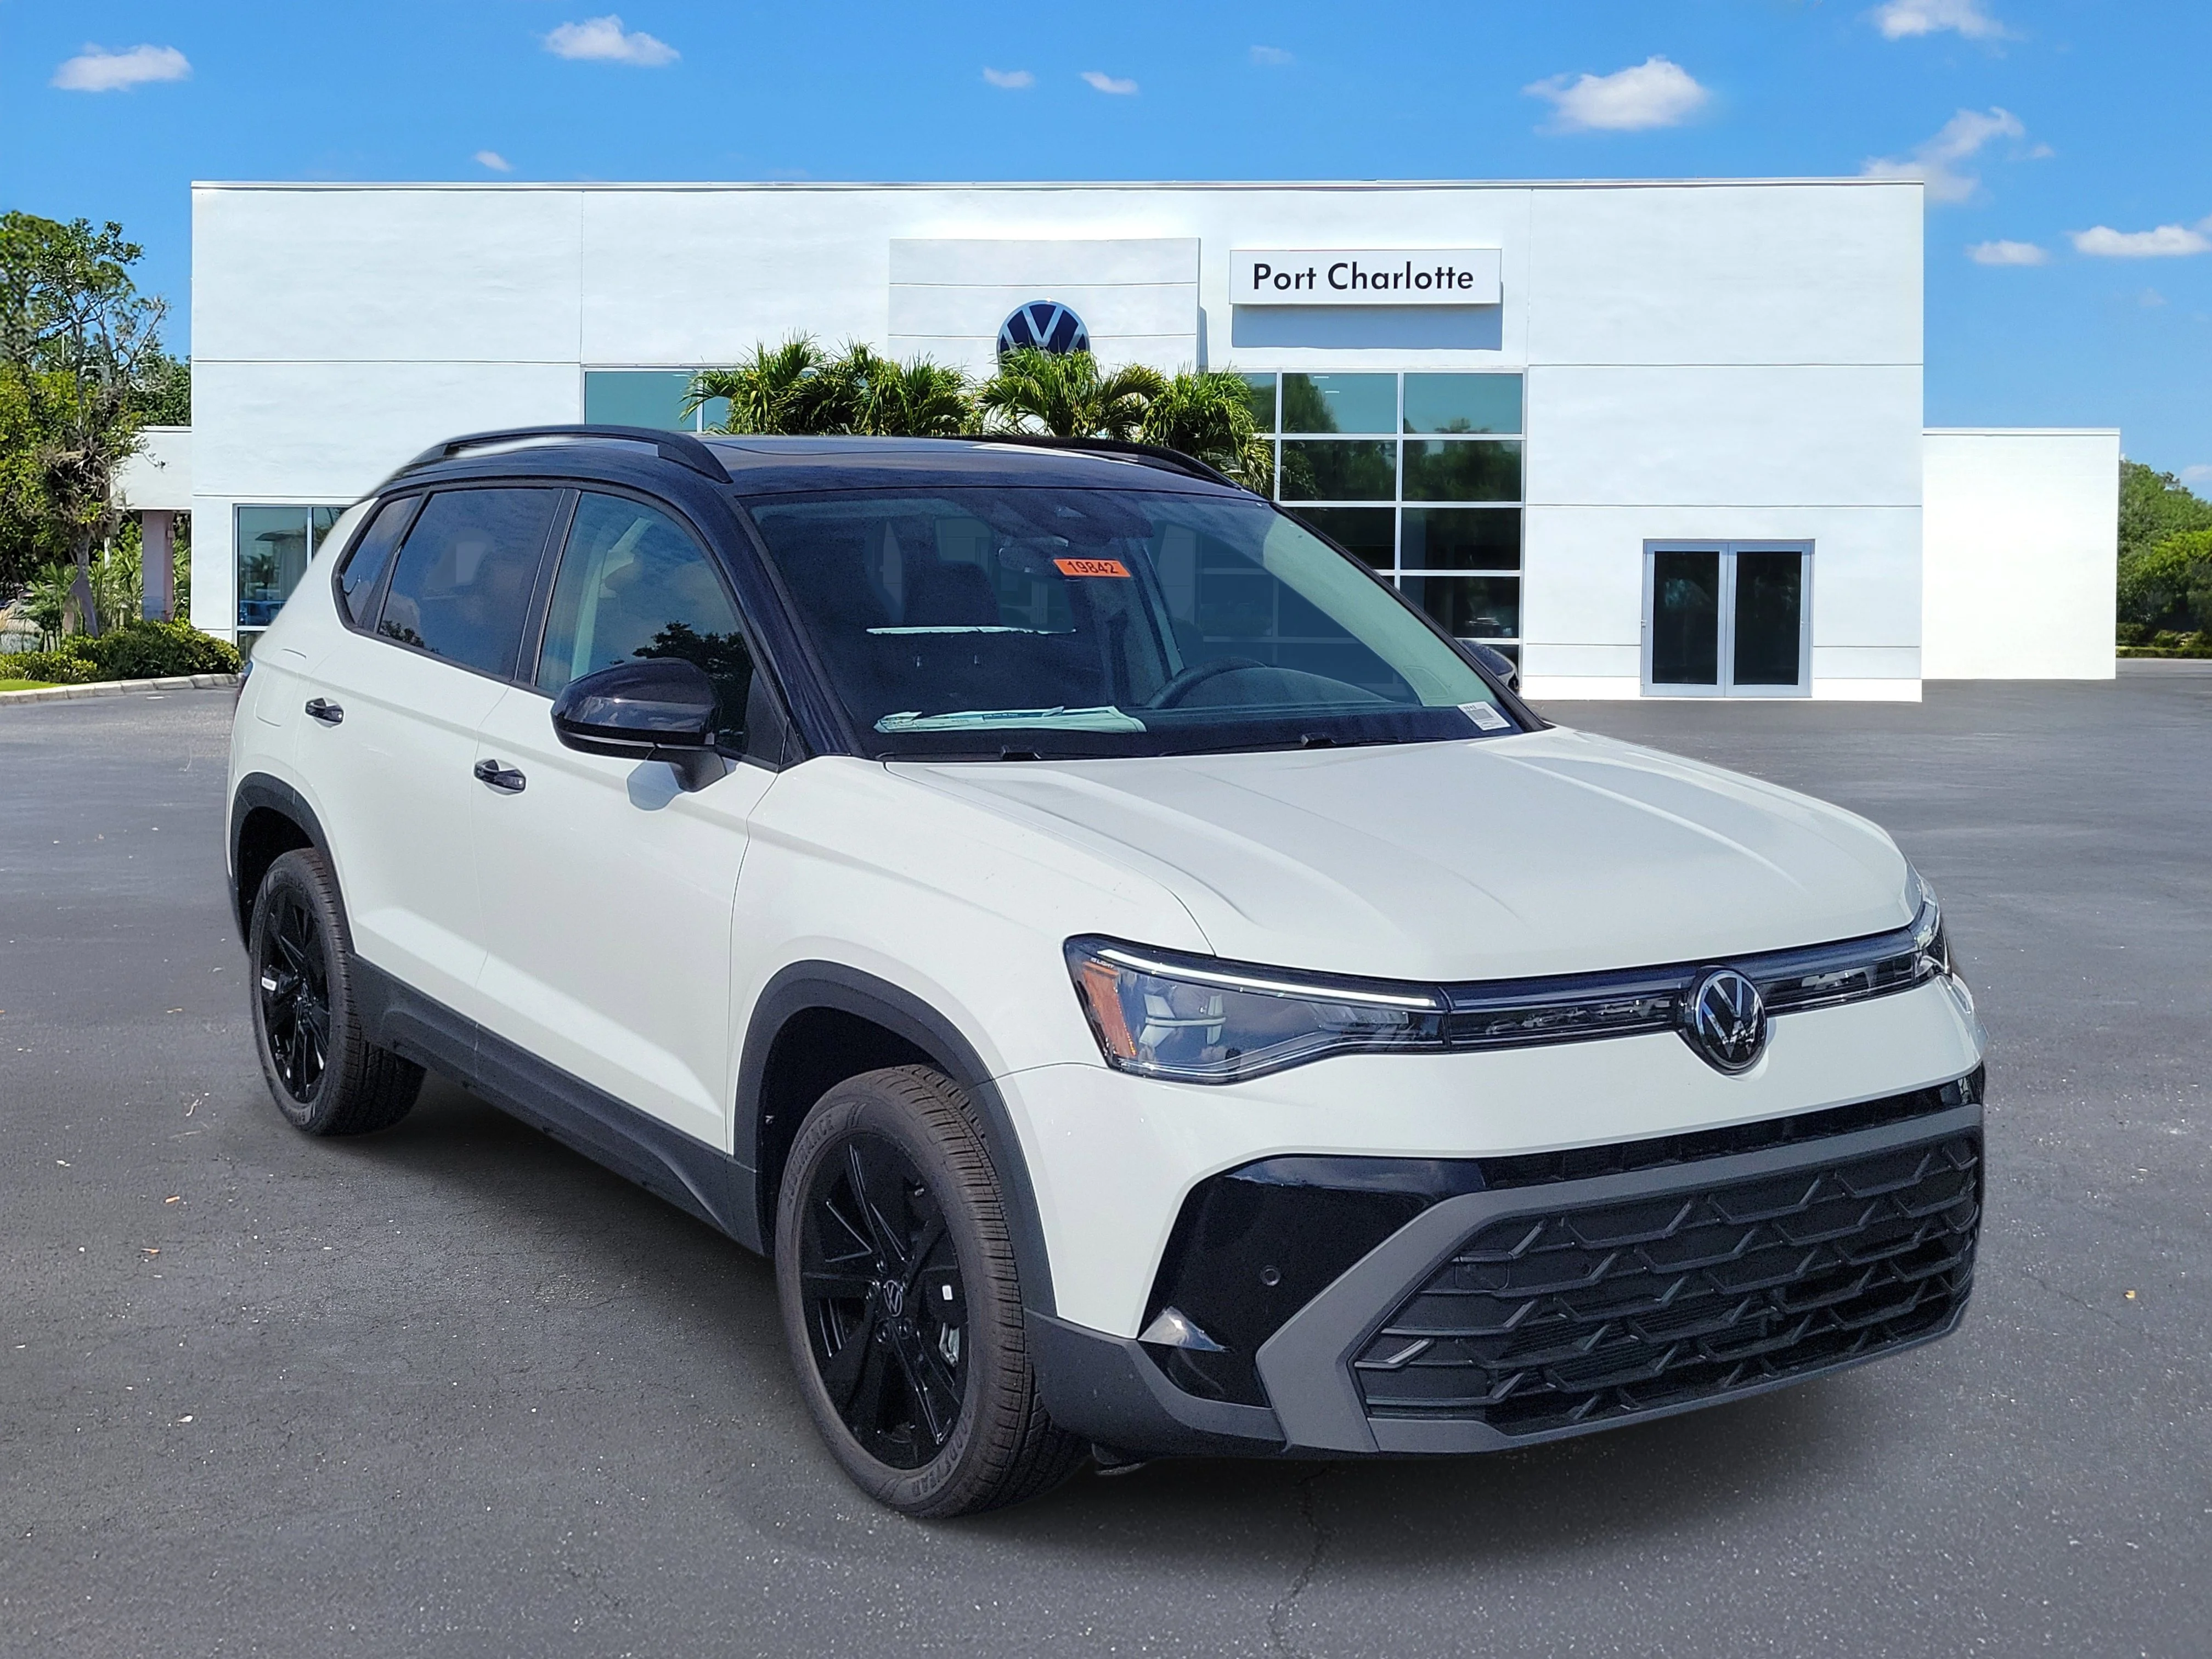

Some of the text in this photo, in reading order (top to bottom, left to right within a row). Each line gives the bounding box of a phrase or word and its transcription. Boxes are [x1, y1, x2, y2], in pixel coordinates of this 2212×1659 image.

[1253, 261, 1474, 290] Port Charlotte
[1067, 561, 1119, 574] 19842
